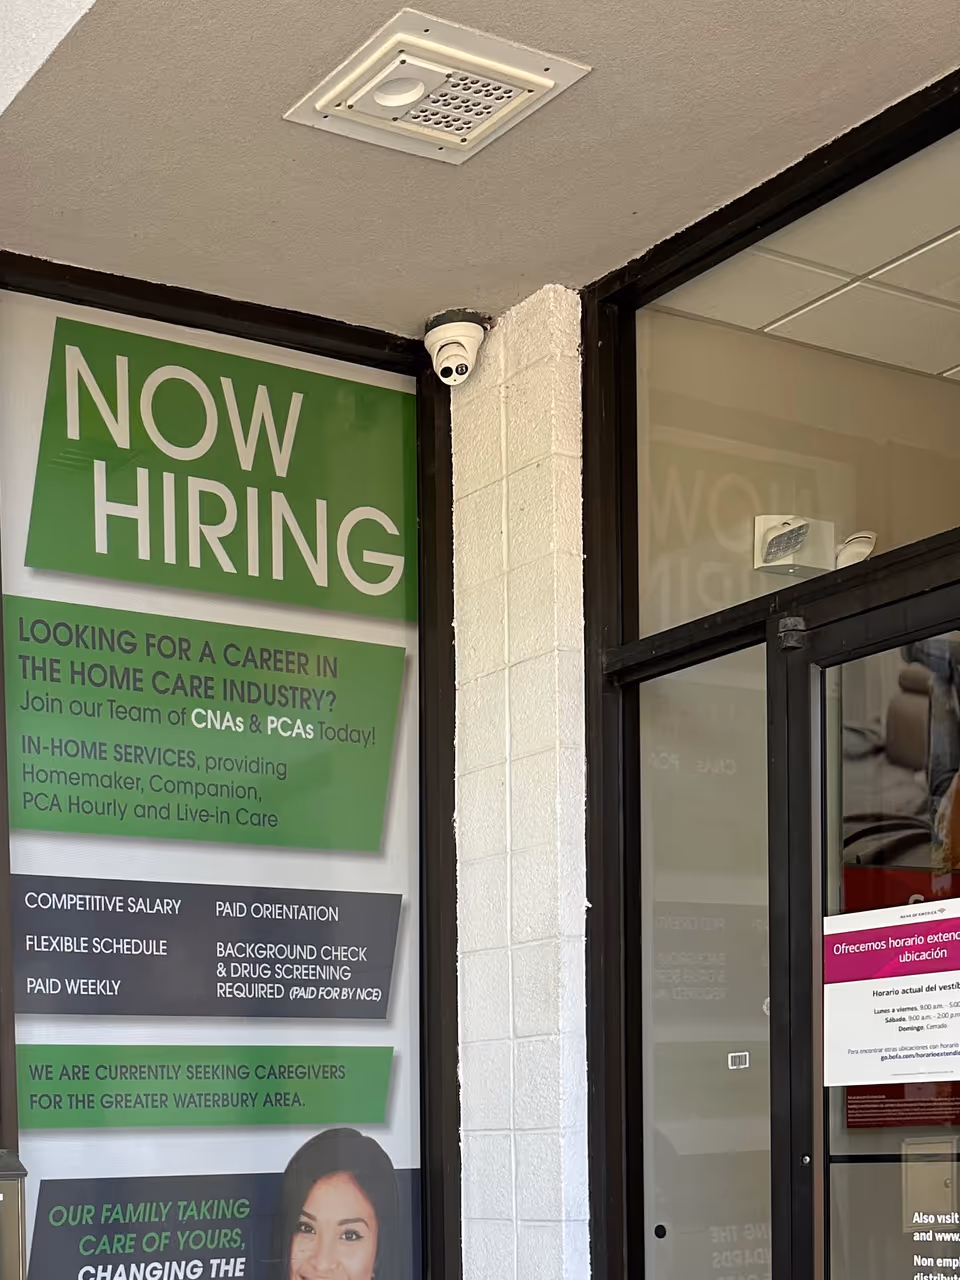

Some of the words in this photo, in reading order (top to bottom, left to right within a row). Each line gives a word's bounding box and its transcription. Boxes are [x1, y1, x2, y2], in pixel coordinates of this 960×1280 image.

[65, 344, 304, 478] NOW
[93, 460, 405, 596] HIRING
[19, 616, 137, 654] LOOKING
[145, 633, 191, 661] FOR
[199, 641, 216, 664] A
[223, 643, 309, 676] CAREER
[316, 655, 337, 679] IN
[18, 655, 61, 683] THE
[70, 660, 143, 692] HOME
[151, 670, 215, 700] CARE
[223, 678, 336, 712] INDUSTRY?
[20, 690, 63, 714] Join
[69, 699, 103, 718] our
[107, 699, 161, 725] Team
[168, 707, 186, 726] of
[191, 708, 244, 732] CNAs
[249, 714, 262, 734] &
[267, 716, 314, 739] PCAs
[317, 721, 376, 748] Today!
[21, 735, 107, 761] IN-HOME
[113, 743, 200, 771] SERVICES,
[205, 755, 287, 781] providing
[22, 763, 144, 794] Homemaker,
[149, 775, 262, 802] Companion,
[23, 792, 62, 812] PCA
[68, 795, 128, 821] Hourly
[134, 803, 171, 820] and
[177, 804, 230, 824] Live-in
[235, 808, 279, 828] Care
[25, 892, 124, 912] COMPETITIVE
[127, 897, 182, 915] SALARY
[216, 901, 247, 918] PAID
[250, 902, 339, 922] ORIENTATION
[25, 935, 89, 953] FLEXIBLE
[92, 937, 167, 955] SCHEDULE
[216, 942, 317, 960] BACKGROUND
[320, 945, 368, 962] CHECK
[833, 940, 886, 955] Ofrecemos
[889, 934, 924, 948] horario
[899, 947, 947, 963] ubicación
[216, 962, 227, 977] &
[231, 962, 271, 979] DRUG
[275, 964, 351, 981] SCREENING
[26, 977, 62, 994] PAID
[65, 979, 121, 995] WEEKLY
[216, 982, 285, 999] REQUIRED
[289, 986, 317, 1000] (PAID
[318, 987, 340, 1000] FOR
[341, 987, 357, 1000] BY
[356, 988, 382, 1002] NCE)
[872, 988, 899, 997] Horario
[901, 985, 923, 995] actual
[925, 984, 936, 992] del
[29, 1065, 53, 1081] WE
[59, 1065, 90, 1081] ARE
[95, 1064, 182, 1080] CURRENTLY
[186, 1064, 250, 1080] SEEKING
[254, 1065, 346, 1080] CAREGIVERS
[30, 1093, 63, 1109] FOR
[67, 1094, 95, 1109] THE
[100, 1093, 168, 1109] GREATER
[172, 1092, 258, 1108] WATERBURY
[262, 1092, 306, 1107] AREA.
[48, 1205, 96, 1227] OUR
[101, 1201, 172, 1224] FAMILY
[177, 1198, 250, 1221] TAKING
[912, 1212, 935, 1224] Also
[937, 1212, 959, 1224] visit
[78, 1233, 137, 1256] CARE
[142, 1231, 171, 1253] OF
[177, 1228, 245, 1251] YOURS,
[913, 1230, 933, 1241] and
[935, 1232, 960, 1242] www.
[209, 1257, 246, 1279] THE
[913, 1255, 934, 1267] Non
